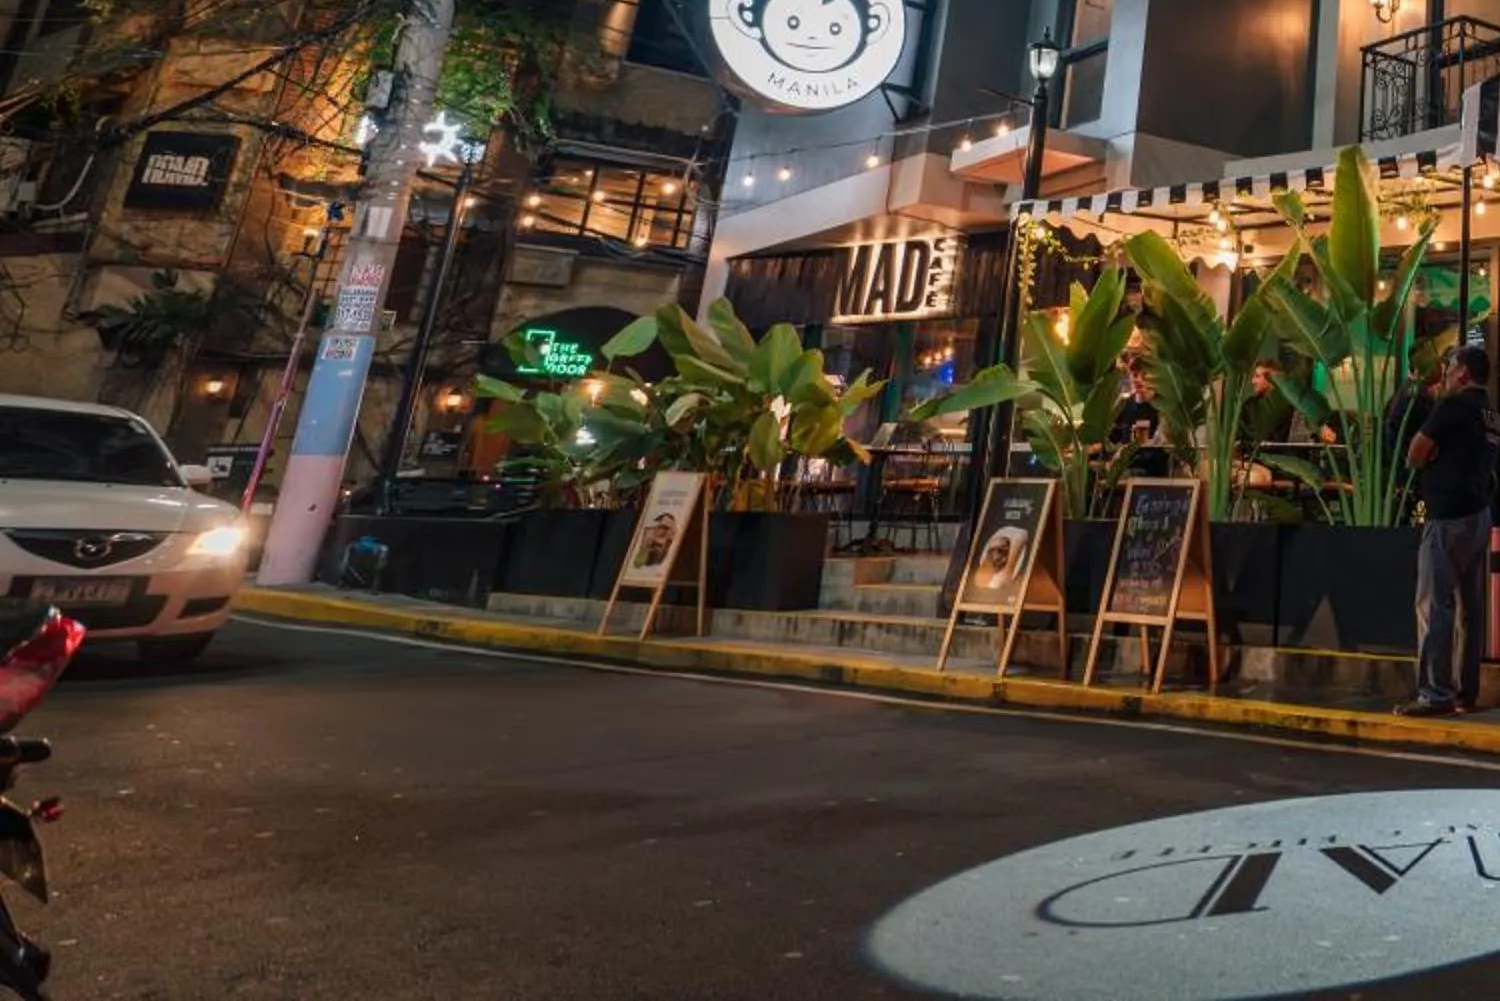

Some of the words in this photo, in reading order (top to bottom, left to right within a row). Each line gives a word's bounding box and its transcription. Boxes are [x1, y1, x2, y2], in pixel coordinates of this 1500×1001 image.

[767, 71, 859, 98] MANILA
[837, 239, 931, 316] MAD
[553, 342, 579, 353] THE
